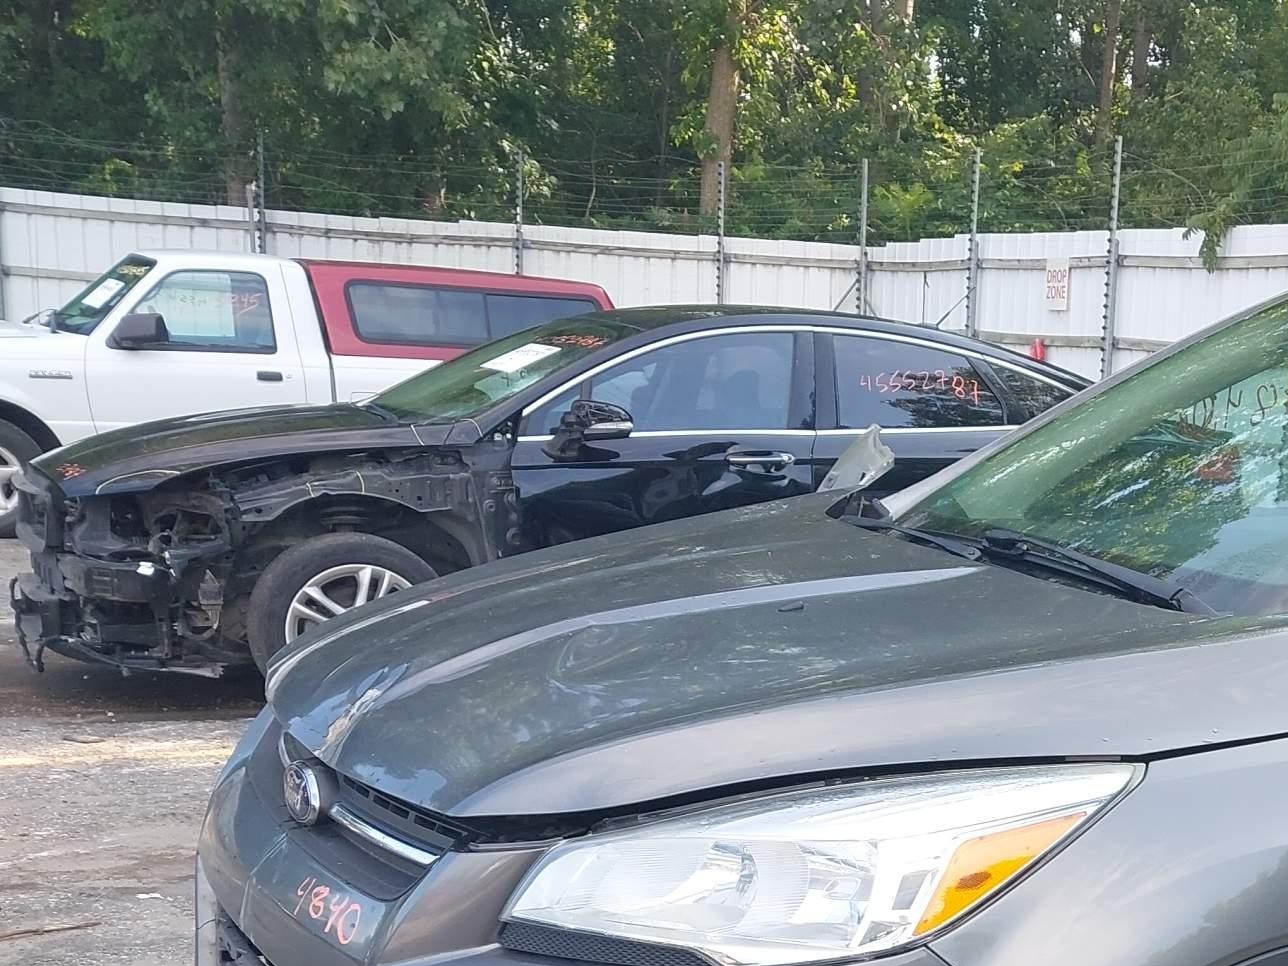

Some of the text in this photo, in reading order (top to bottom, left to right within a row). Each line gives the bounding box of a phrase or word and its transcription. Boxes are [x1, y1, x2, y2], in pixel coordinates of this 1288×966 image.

[1047, 269, 1067, 284] DROP
[1047, 285, 1066, 299] ZONE
[859, 369, 994, 406] 45552787
[293, 876, 361, 946] 4840
